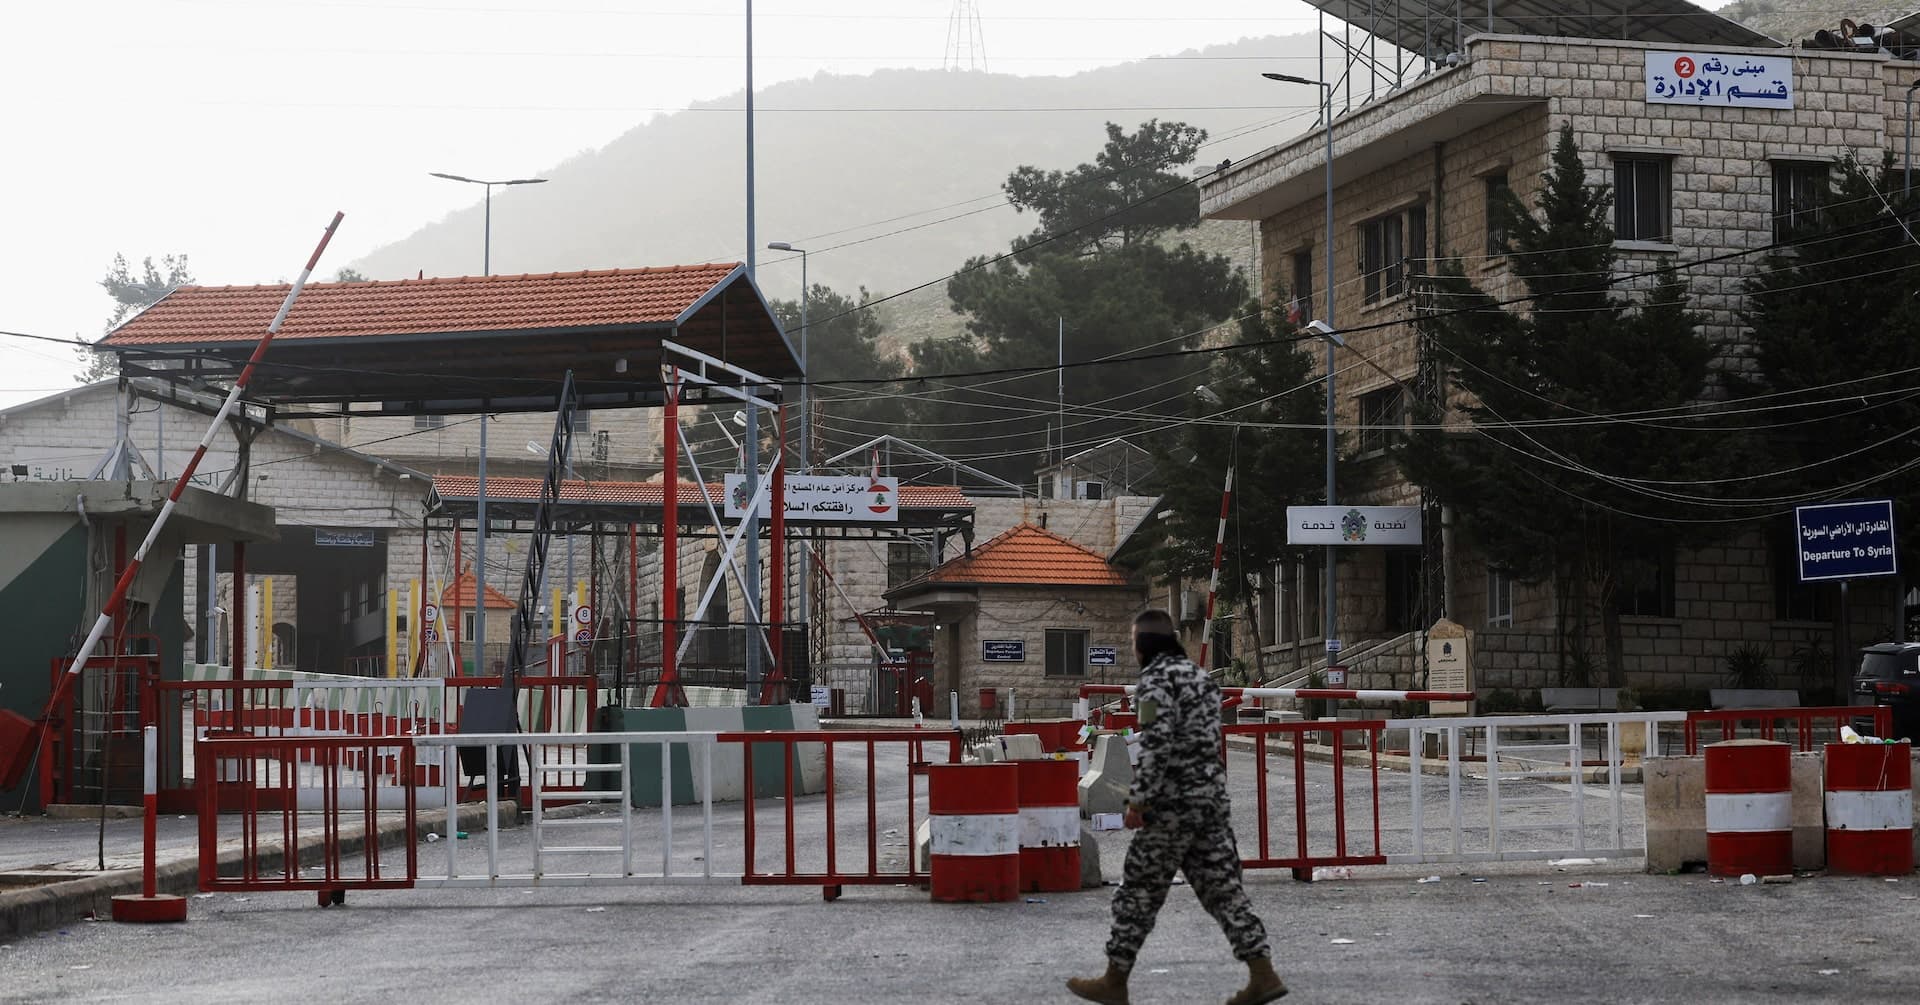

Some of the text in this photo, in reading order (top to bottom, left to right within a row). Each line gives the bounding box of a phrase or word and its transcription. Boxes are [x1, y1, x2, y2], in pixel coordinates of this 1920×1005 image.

[1679, 57, 1766, 77] مبنى رقم 2
[1653, 76, 1788, 103] قسم الإدارة
[791, 482, 815, 494] المصنع
[816, 483, 831, 494] عام
[846, 483, 864, 494] مركز
[811, 501, 854, 515] رافقتكم
[1301, 520, 1407, 532] تضحية خدمة
[1866, 520, 1889, 534] المغادرة
[1802, 525, 1828, 541] السورية
[1803, 545, 1892, 563] Departure To Syria
[426, 608, 433, 617] 8
[582, 609, 588, 617] 8
